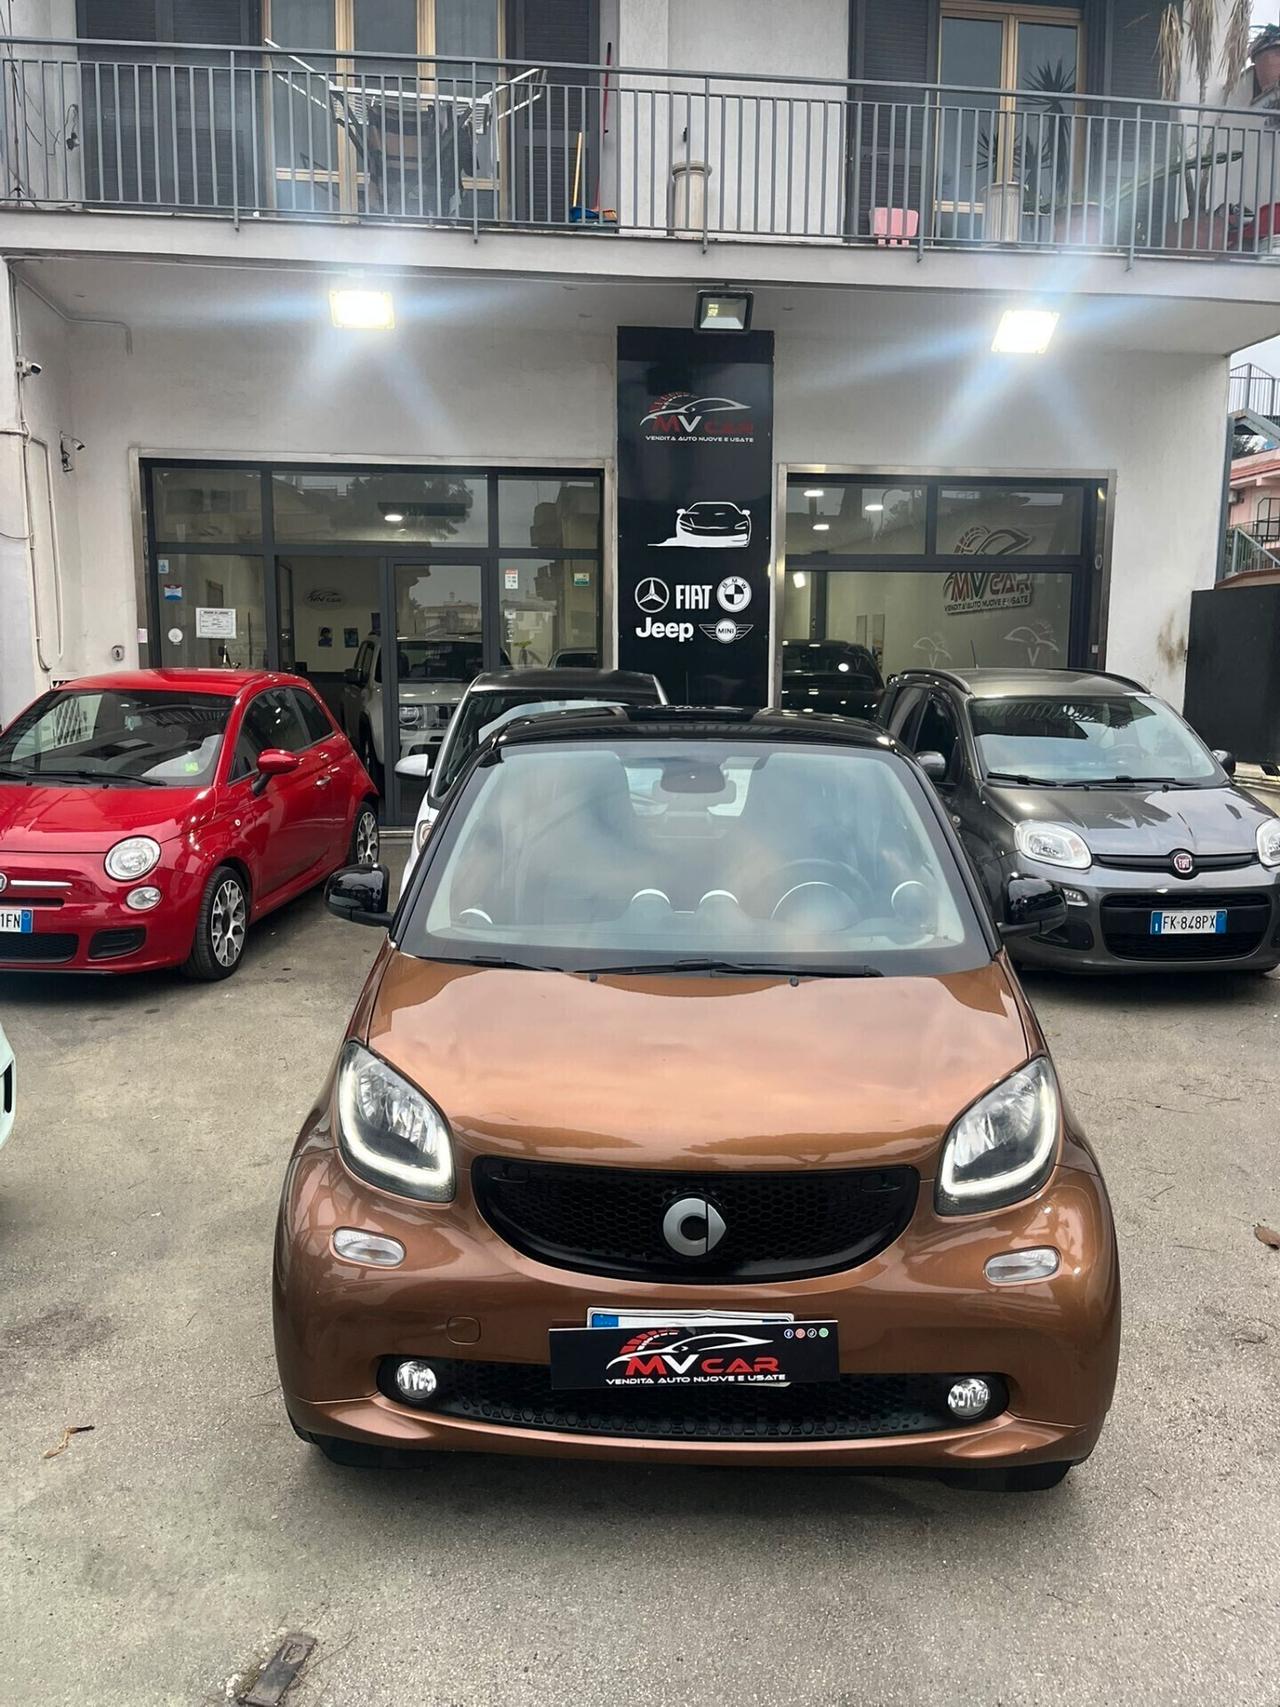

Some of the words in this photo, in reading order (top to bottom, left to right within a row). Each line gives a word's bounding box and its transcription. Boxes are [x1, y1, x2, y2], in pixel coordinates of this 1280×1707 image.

[652, 415, 702, 433] MV
[675, 585, 713, 609] FIAT
[635, 617, 694, 642] Jeep
[625, 1354, 700, 1375] MV
[701, 1357, 780, 1374] CAR
[606, 1377, 655, 1385] VENDITA
[657, 1376, 691, 1384] AUTO
